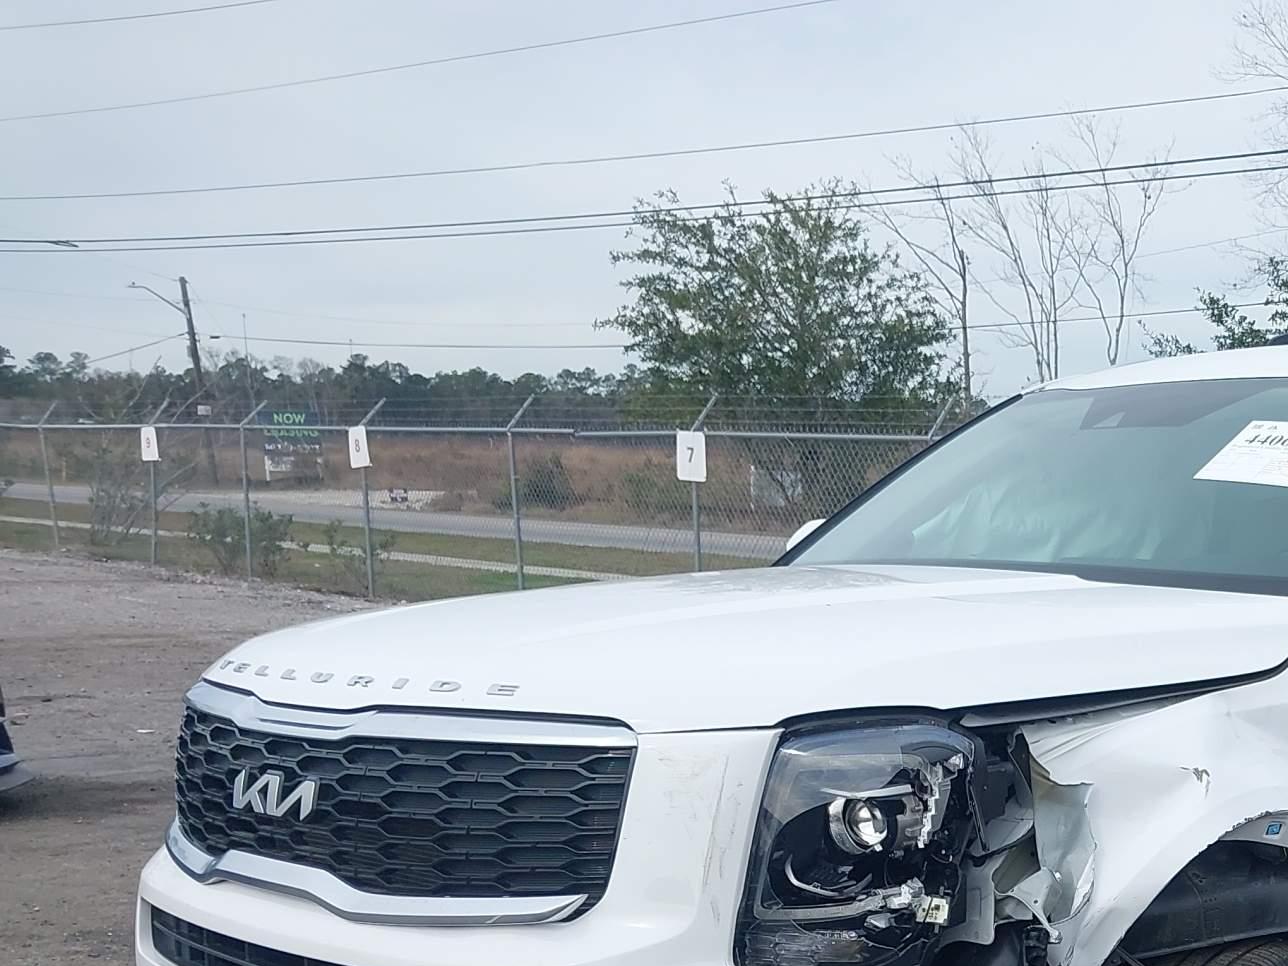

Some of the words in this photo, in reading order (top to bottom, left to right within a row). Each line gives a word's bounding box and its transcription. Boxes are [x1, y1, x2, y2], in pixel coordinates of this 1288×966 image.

[273, 413, 306, 424] NOW
[354, 439, 361, 453] 8
[687, 447, 694, 463] 7
[219, 659, 520, 697] TELLURIDE
